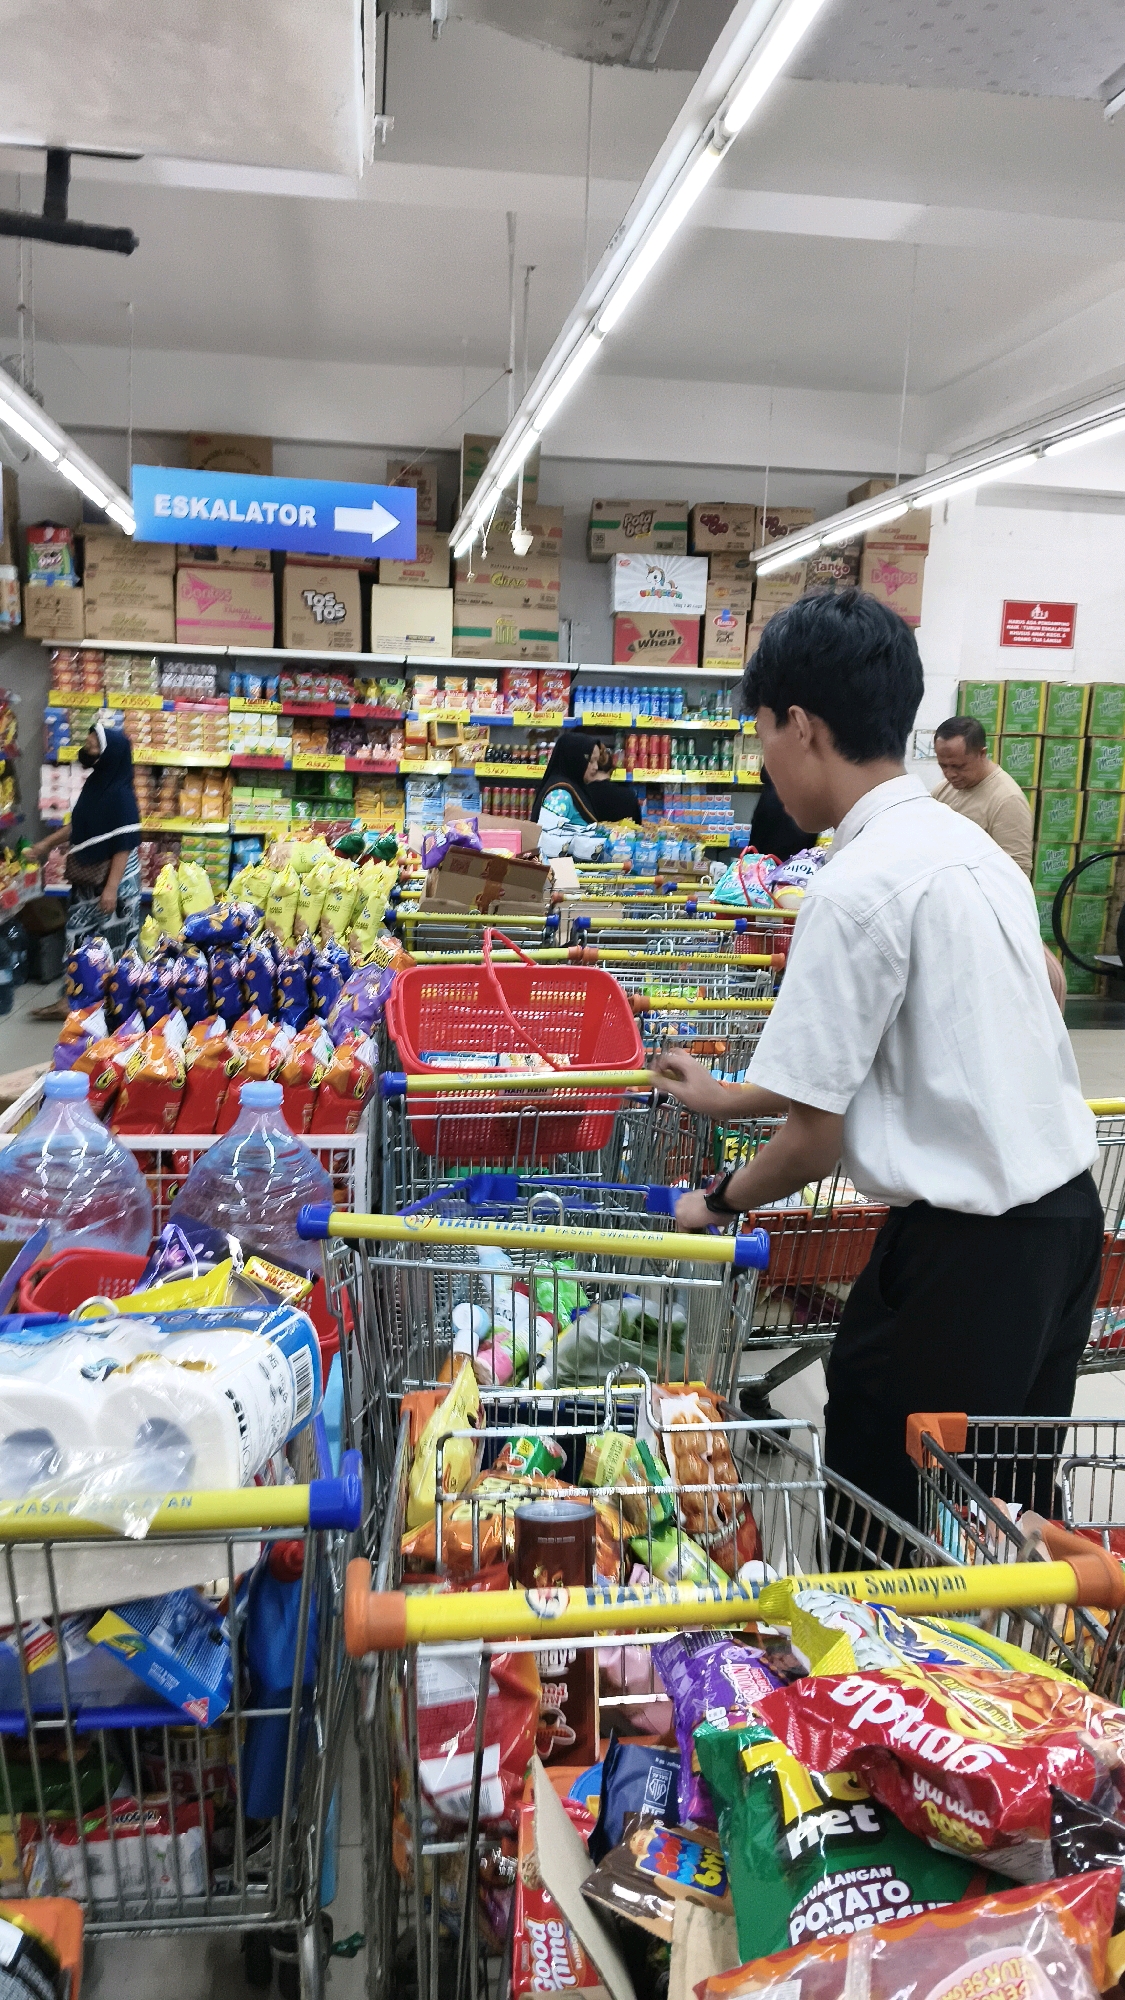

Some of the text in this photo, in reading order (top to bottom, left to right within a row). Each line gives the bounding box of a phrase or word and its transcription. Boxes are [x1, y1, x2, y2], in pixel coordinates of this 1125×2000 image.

[154, 493, 317, 529] ESKALATOR
[812, 560, 850, 579] Tango
[303, 590, 336, 607] TOS
[312, 603, 347, 622] TOS
[638, 635, 685, 650] Wheat
[649, 628, 675, 640] Van
[864, 1572, 968, 1598] Swalayan
[786, 1803, 881, 1861] net
[788, 1879, 910, 1946] POTATO
[524, 1915, 557, 1993] Good
[546, 1917, 579, 1990] Time
